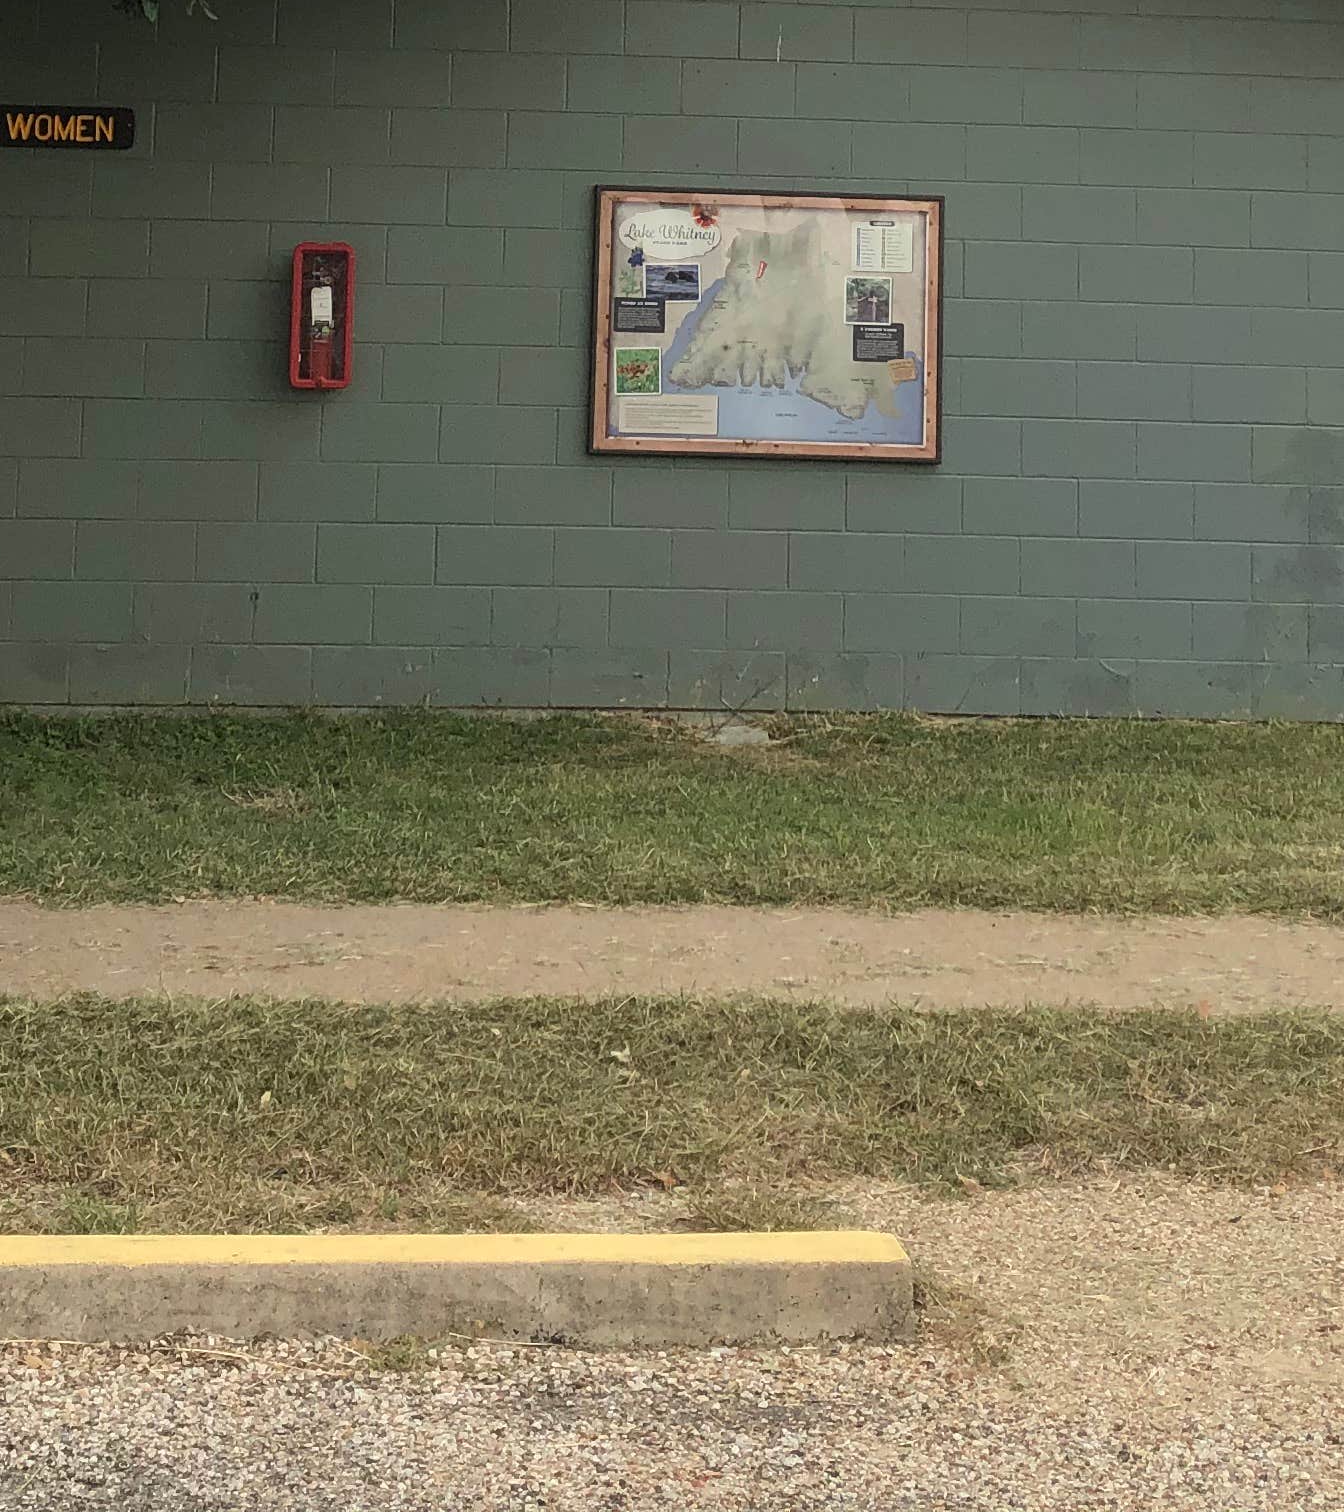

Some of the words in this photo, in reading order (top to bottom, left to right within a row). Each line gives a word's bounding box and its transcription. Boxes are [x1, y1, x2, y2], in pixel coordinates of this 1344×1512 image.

[7, 113, 114, 142] WOMEN
[624, 223, 656, 241] Lake
[659, 223, 716, 245] Whitney
